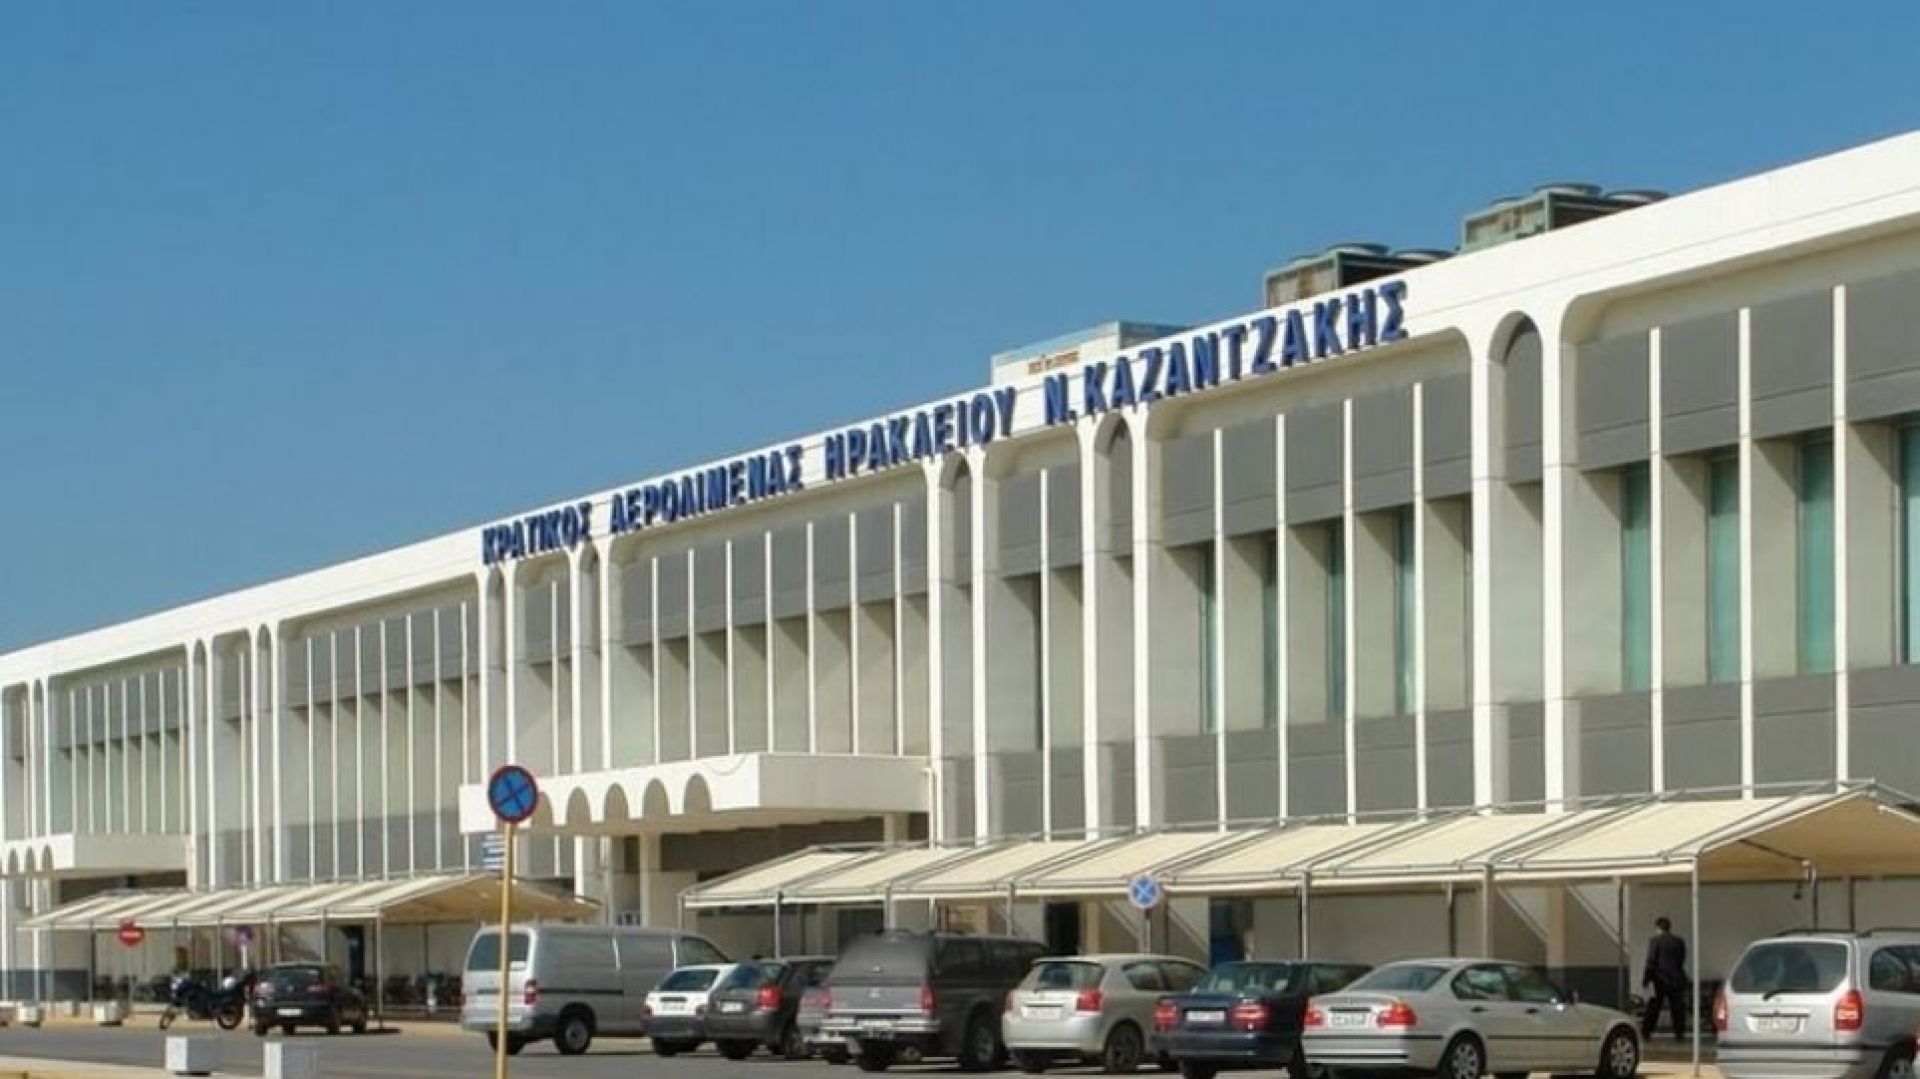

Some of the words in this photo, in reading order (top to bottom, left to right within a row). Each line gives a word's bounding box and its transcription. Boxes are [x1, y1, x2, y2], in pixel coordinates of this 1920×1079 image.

[483, 502, 592, 565] ΚΡΑΤΙΚΟΣ
[610, 444, 803, 534] ΑΕΡΟΛΙΜΕΝΑΣ
[825, 387, 1016, 480] ΗΡΑΚΛΕΙΟΥ
